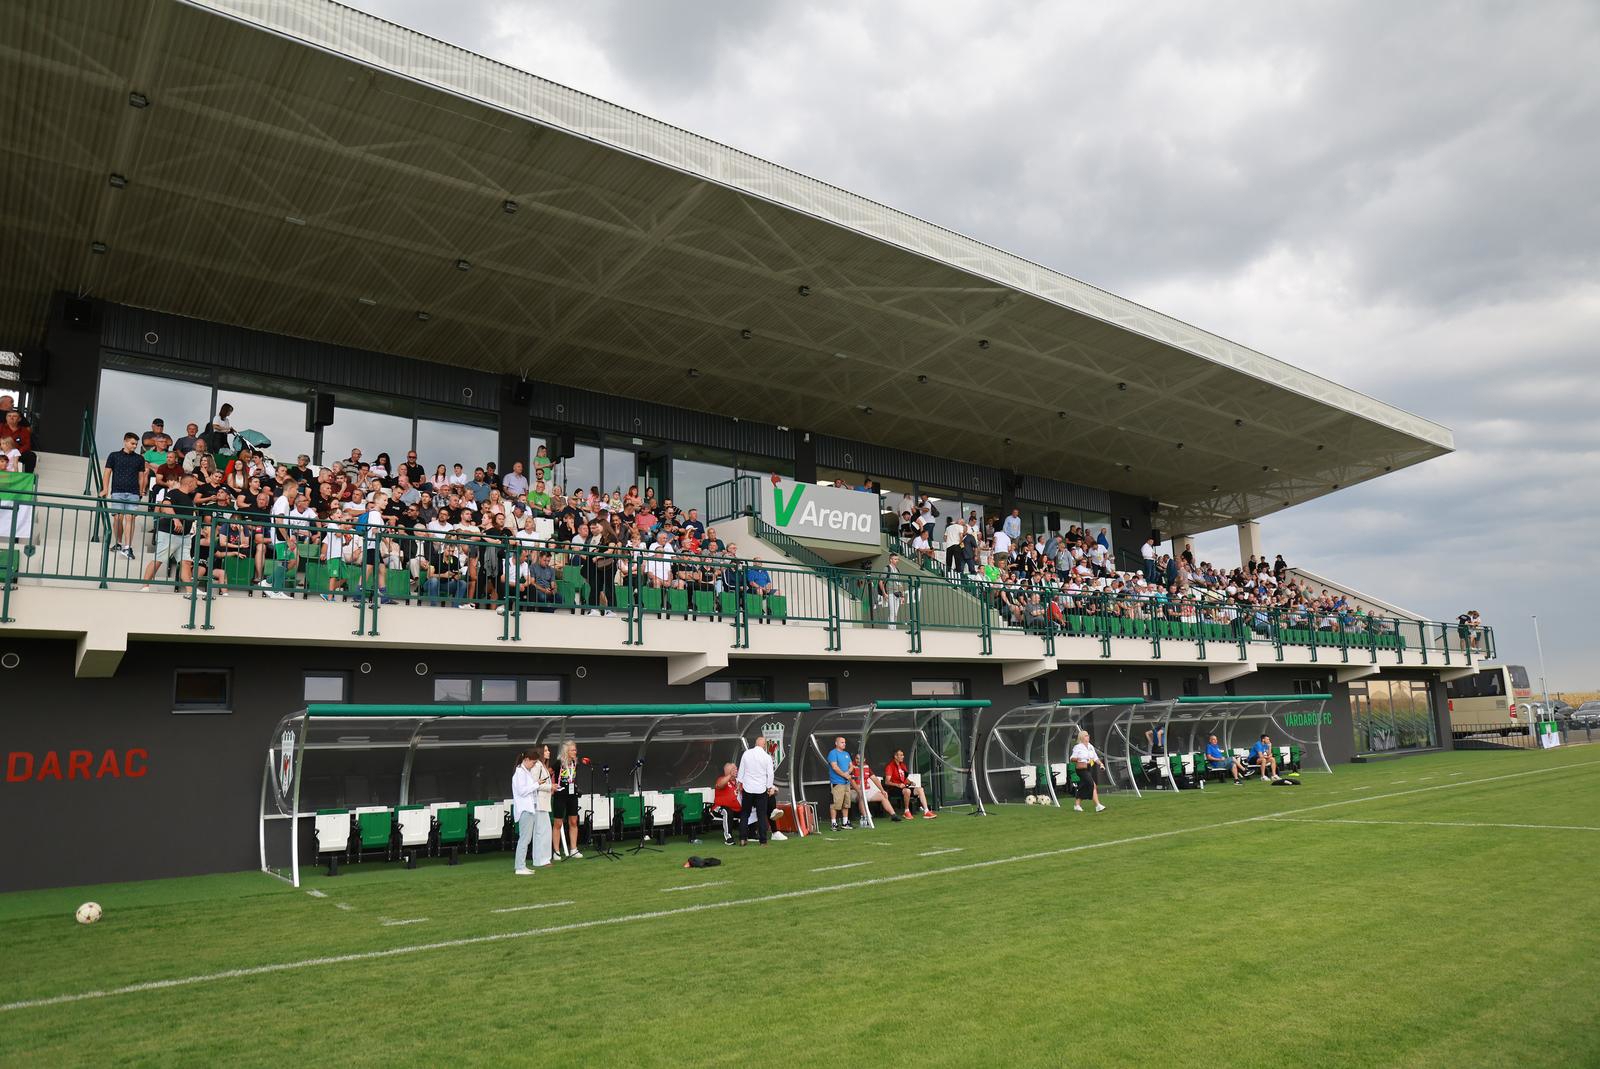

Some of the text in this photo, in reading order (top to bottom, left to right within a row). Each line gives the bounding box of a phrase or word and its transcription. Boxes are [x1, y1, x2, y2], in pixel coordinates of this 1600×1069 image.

[773, 483, 872, 533] V Arena
[1323, 712, 1332, 725] FC
[0, 748, 148, 782] DARAC
